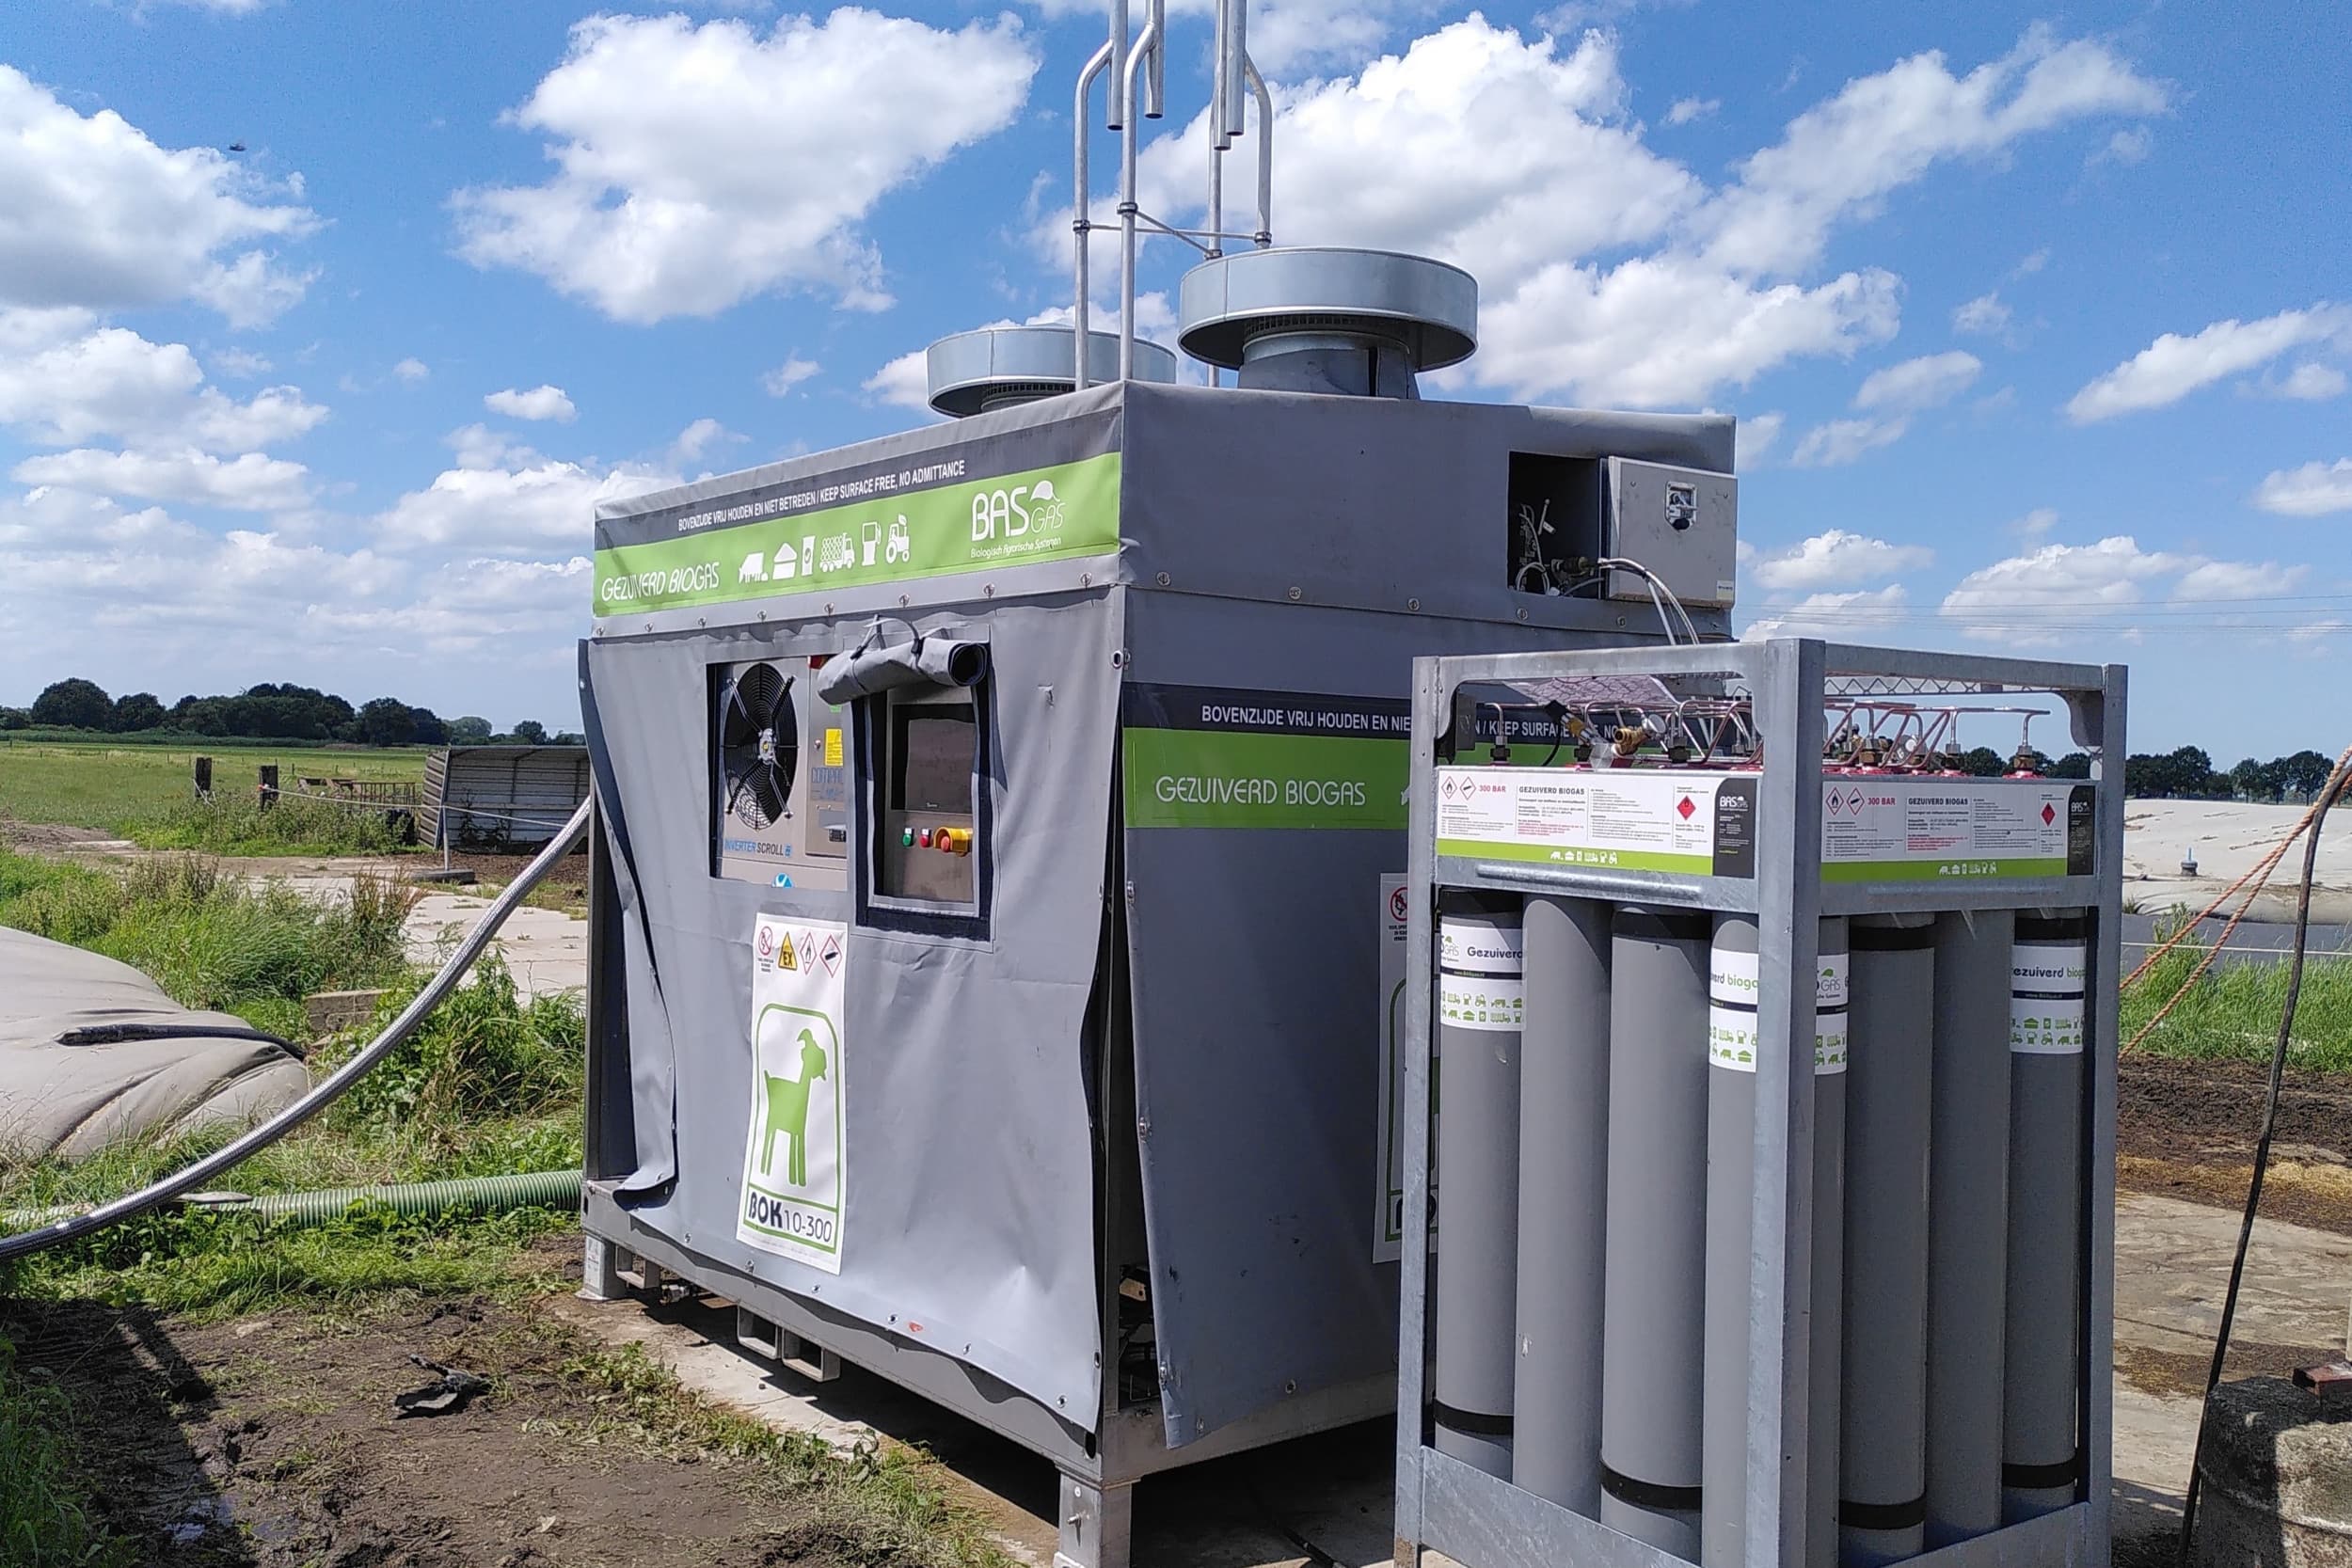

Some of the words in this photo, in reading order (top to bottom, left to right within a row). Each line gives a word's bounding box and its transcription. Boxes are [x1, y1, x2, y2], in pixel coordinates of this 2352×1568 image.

[678, 515, 712, 531] BOVENZIJDE
[713, 509, 727, 525] VRIJ
[727, 504, 754, 521] HOUDEN
[755, 502, 763, 516] EN
[764, 499, 779, 514] NIET
[779, 491, 817, 511] BETREDEN
[819, 486, 839, 502] KEEP
[840, 478, 874, 499] SURFACE
[874, 474, 898, 491] FREE,
[898, 470, 912, 487] NO
[912, 460, 965, 484] ADMITTANCE
[972, 486, 1029, 541] BAS
[1030, 502, 1066, 532] GAS
[970, 545, 1004, 559] Biologisch
[601, 571, 666, 601] GEZUIVERD
[668, 562, 720, 594] BIOGAS
[1201, 705, 1284, 726] BOVENZIJDE
[1287, 710, 1313, 727] VRIJ
[1317, 712, 1369, 730] HOUDEN
[1372, 715, 1389, 731] EN
[1391, 716, 1411, 732] NIE
[1155, 776, 1278, 804] GEZUIVERD
[1285, 780, 1366, 806] BIOGAS
[1479, 784, 1491, 793] 300
[1518, 786, 1558, 795] GEZUIVERD
[1719, 796, 1737, 808] BAS
[756, 842, 784, 856] SCROLL
[783, 951, 793, 967] EX
[2012, 966, 2064, 978] ezuiverd
[1727, 973, 1758, 990] bioga
[1820, 978, 1841, 992] GAS
